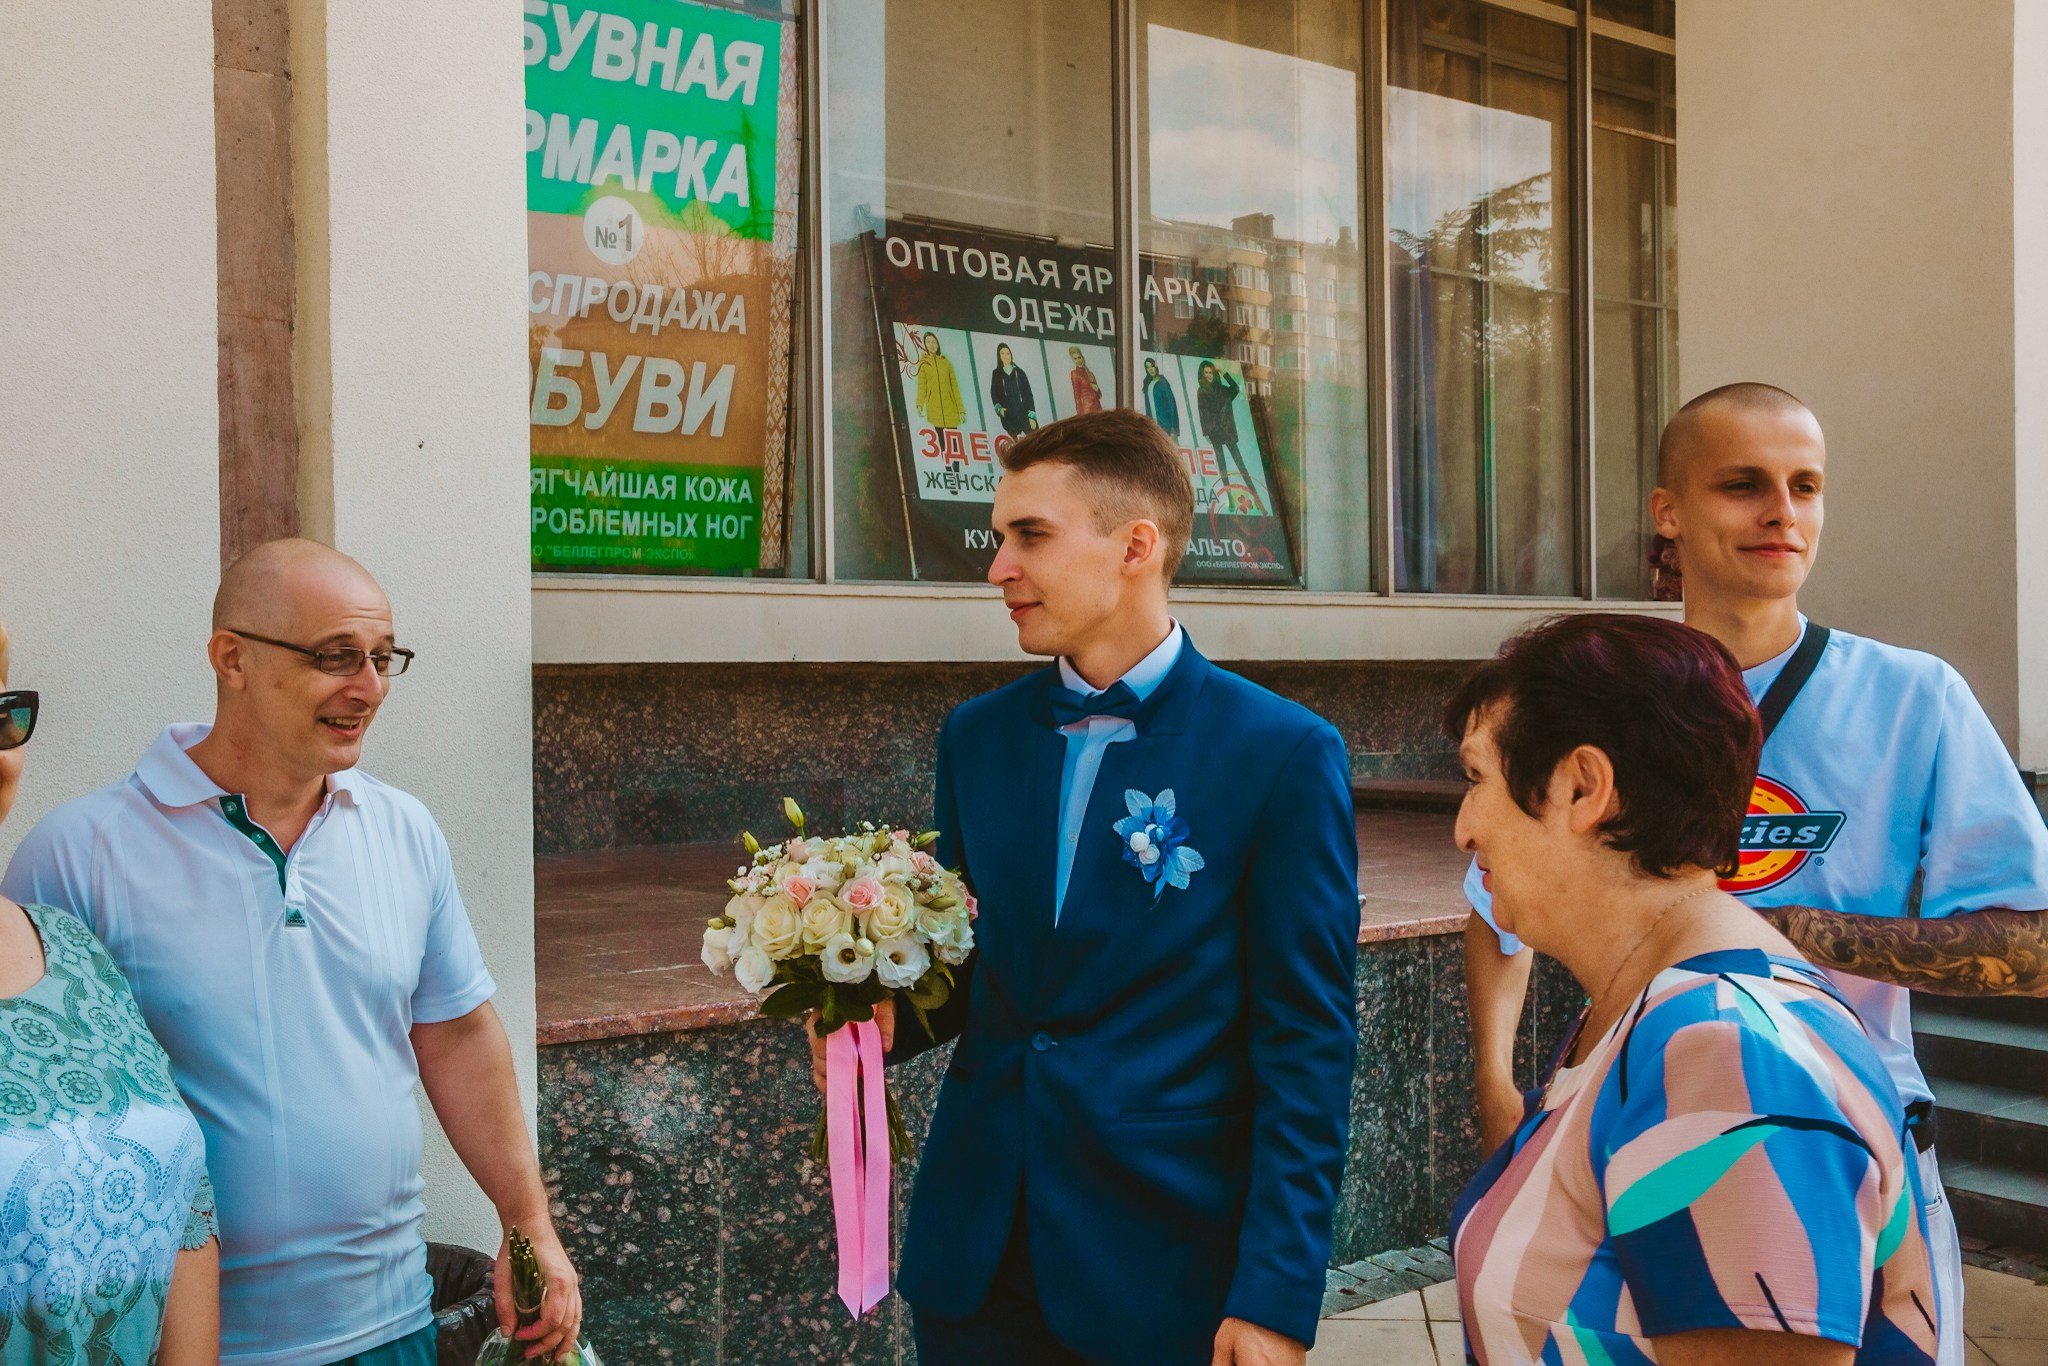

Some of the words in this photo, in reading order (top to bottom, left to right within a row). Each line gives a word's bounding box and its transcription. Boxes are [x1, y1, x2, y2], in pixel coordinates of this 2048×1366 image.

[886, 236, 1061, 289] ОПТОВАЯ
[1071, 264, 1226, 312] ЯРАРКА
[528, 270, 747, 336] СПРОДАЖА
[992, 294, 1148, 341] ОДЕЖД
[529, 346, 736, 438] БУВИ
[530, 465, 677, 501] ЯГЧАЙШАЯ
[685, 475, 753, 504] КОЖА
[924, 471, 1002, 492] ЖЕНСК
[532, 506, 699, 539] РОБЛЕМНЫХ
[705, 515, 753, 540] НОГ
[1196, 560, 1212, 568] ООО
